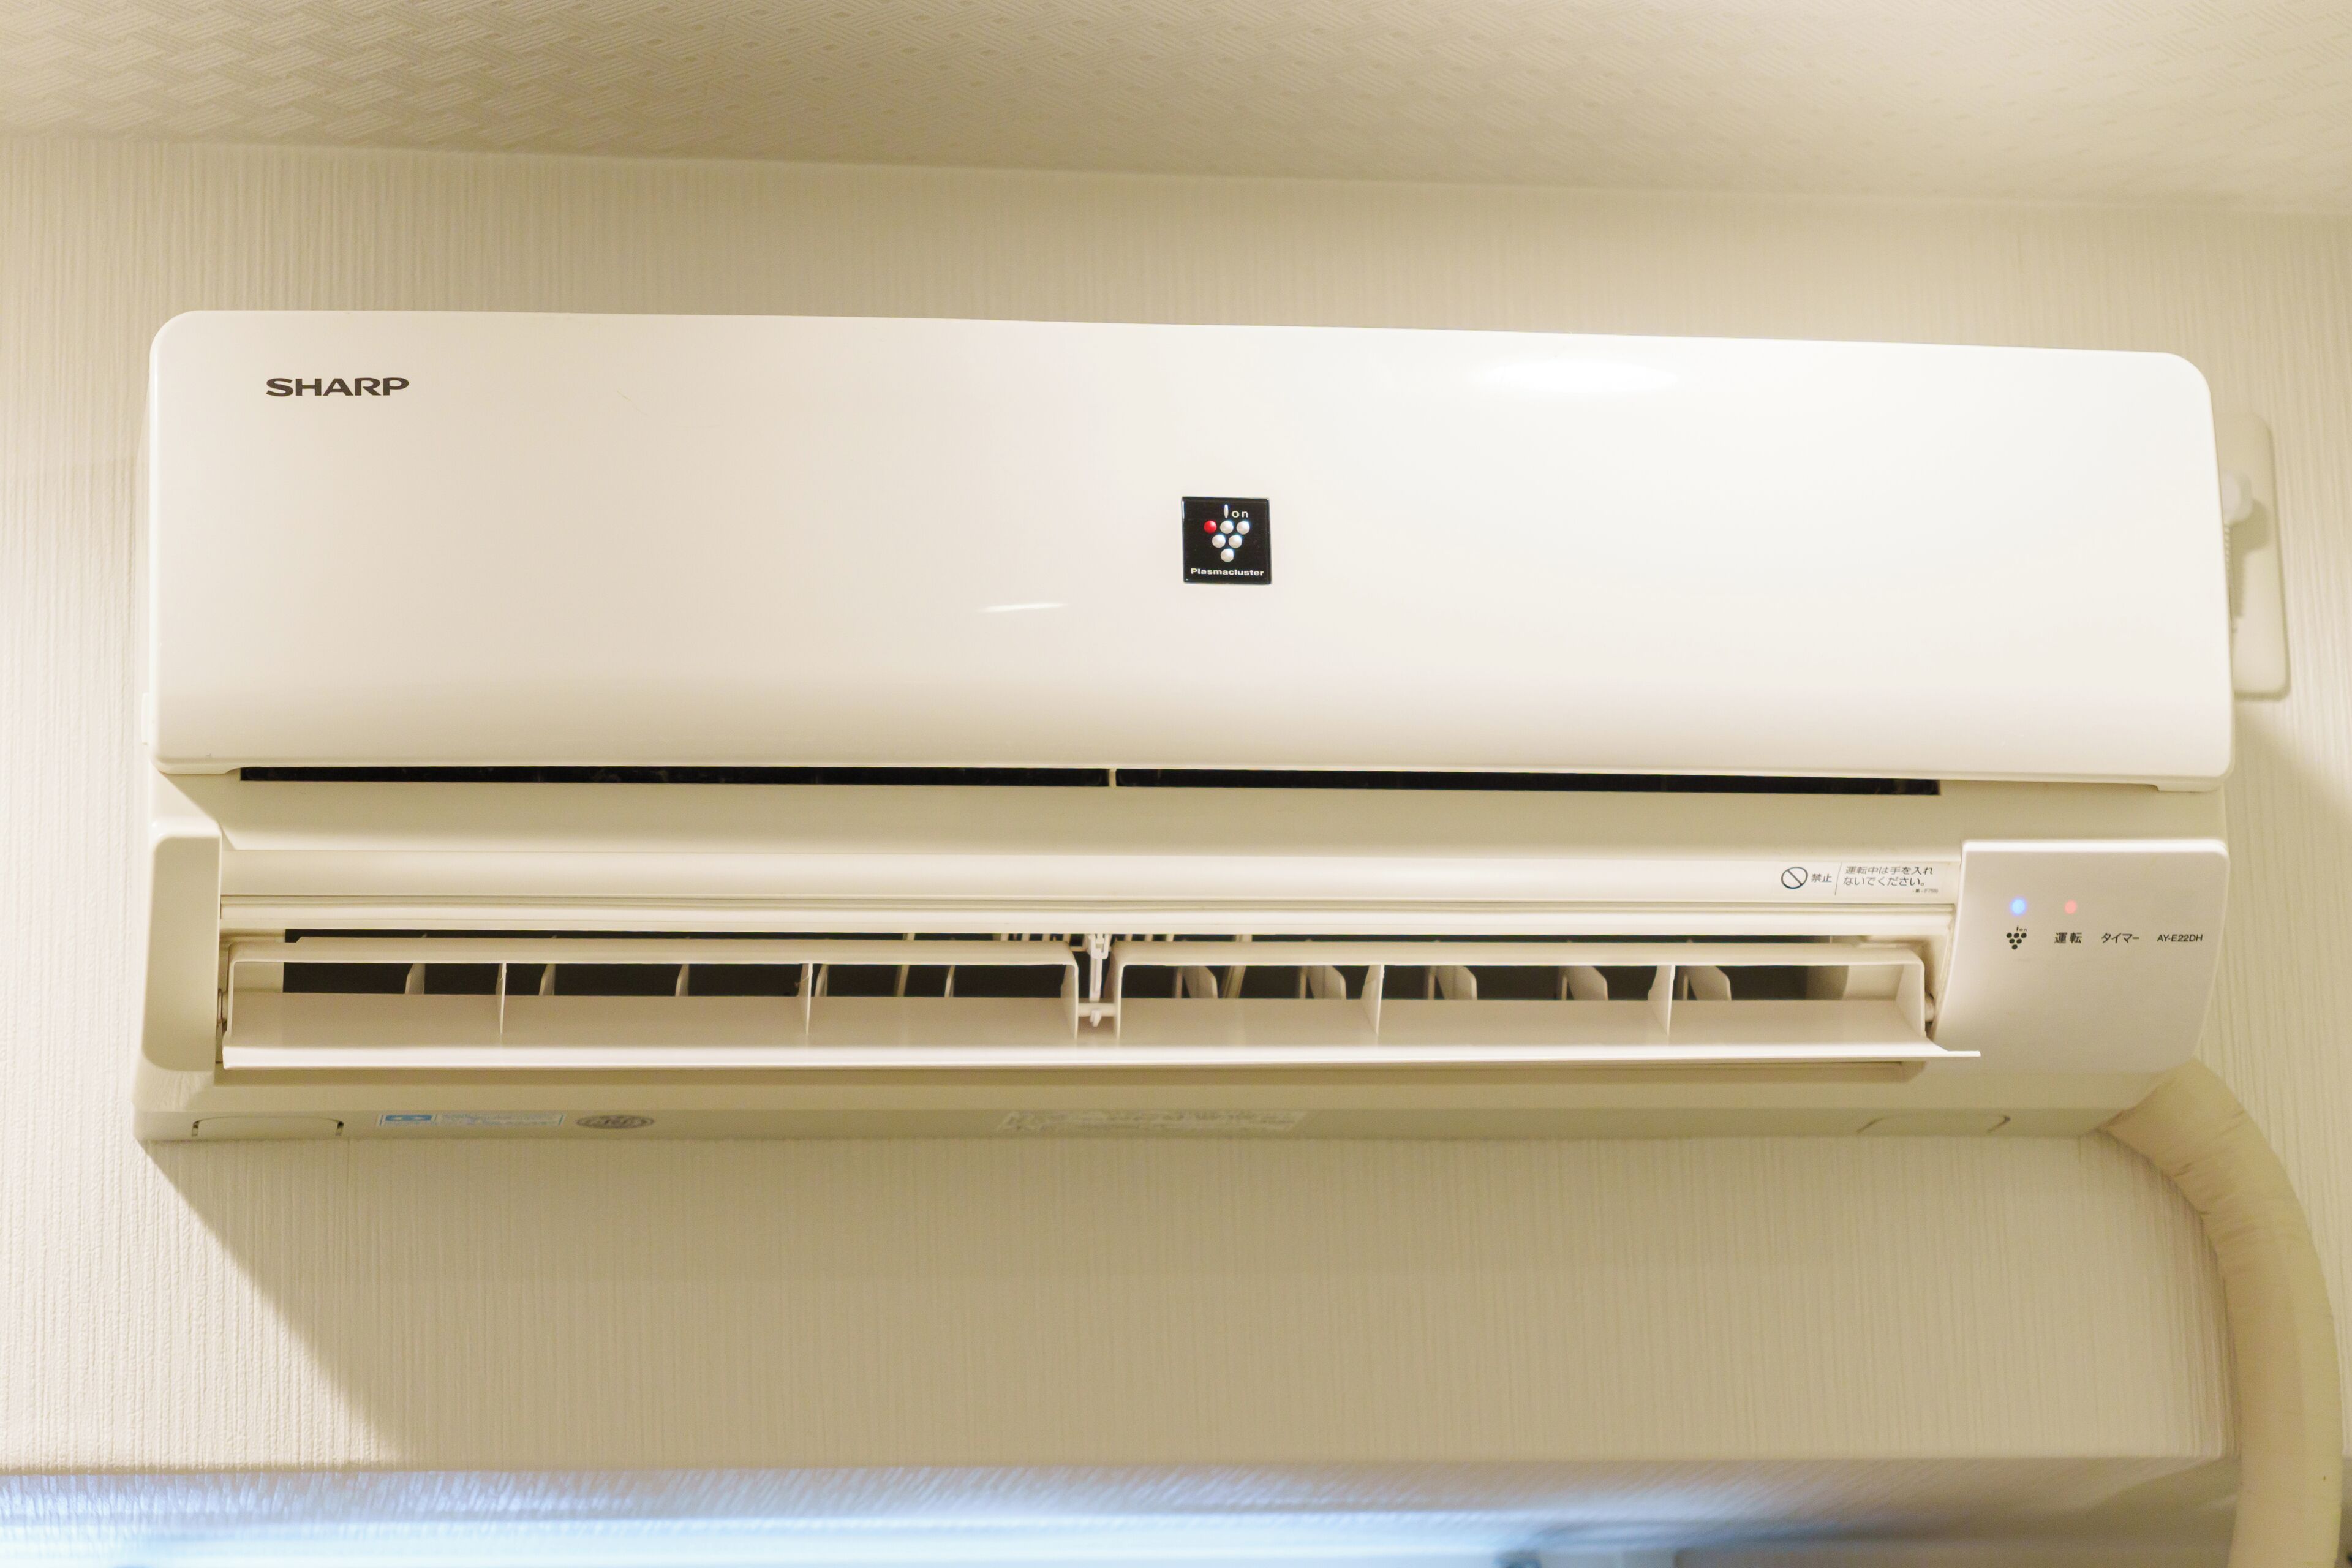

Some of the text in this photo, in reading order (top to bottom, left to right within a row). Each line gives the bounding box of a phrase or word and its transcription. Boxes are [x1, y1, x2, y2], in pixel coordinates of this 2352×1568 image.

[266, 377, 409, 397] SHARP
[1190, 568, 1265, 576] Plasmacluster
[1845, 865, 1934, 875] 運転中は手を入れ
[1810, 873, 1833, 883] 禁止
[1842, 876, 1926, 887] ないでください。
[2054, 932, 2082, 944] 運転
[2101, 932, 2140, 944] タイマー
[2157, 934, 2203, 943] AY-E22DH
